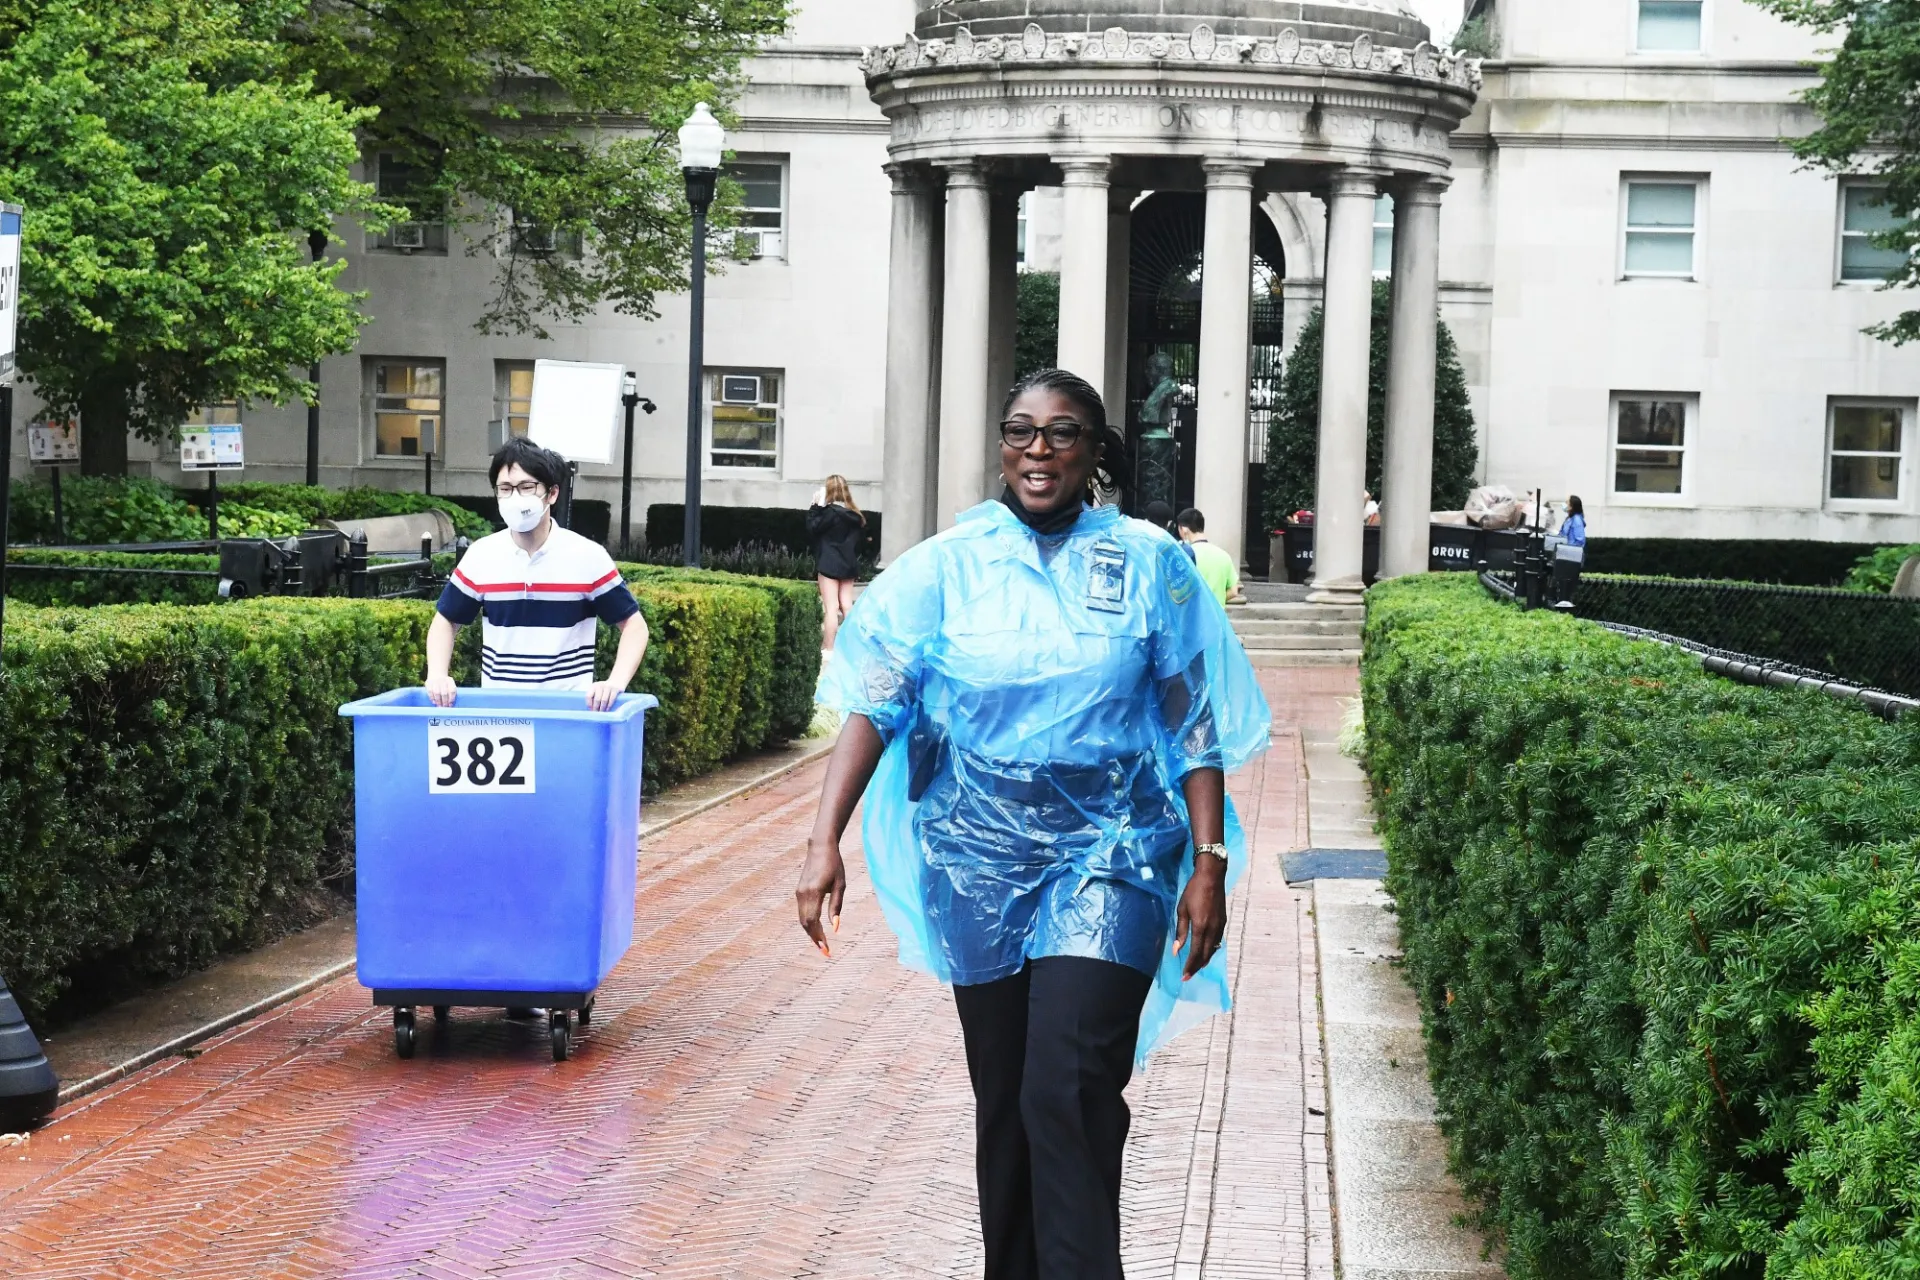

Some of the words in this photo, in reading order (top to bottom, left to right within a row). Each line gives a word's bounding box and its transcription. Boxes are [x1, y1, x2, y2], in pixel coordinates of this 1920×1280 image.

[935, 106, 1010, 131] BELOVED
[1015, 105, 1040, 128] BY
[1042, 104, 1207, 129] GENERATIONS
[1214, 105, 1242, 131] OF
[1251, 108, 1358, 137] COLUMBIA
[1432, 546, 1470, 559] GROVE
[444, 718, 489, 727] COLUMBIA
[490, 718, 531, 727] HOUSING
[436, 736, 525, 787] 382
